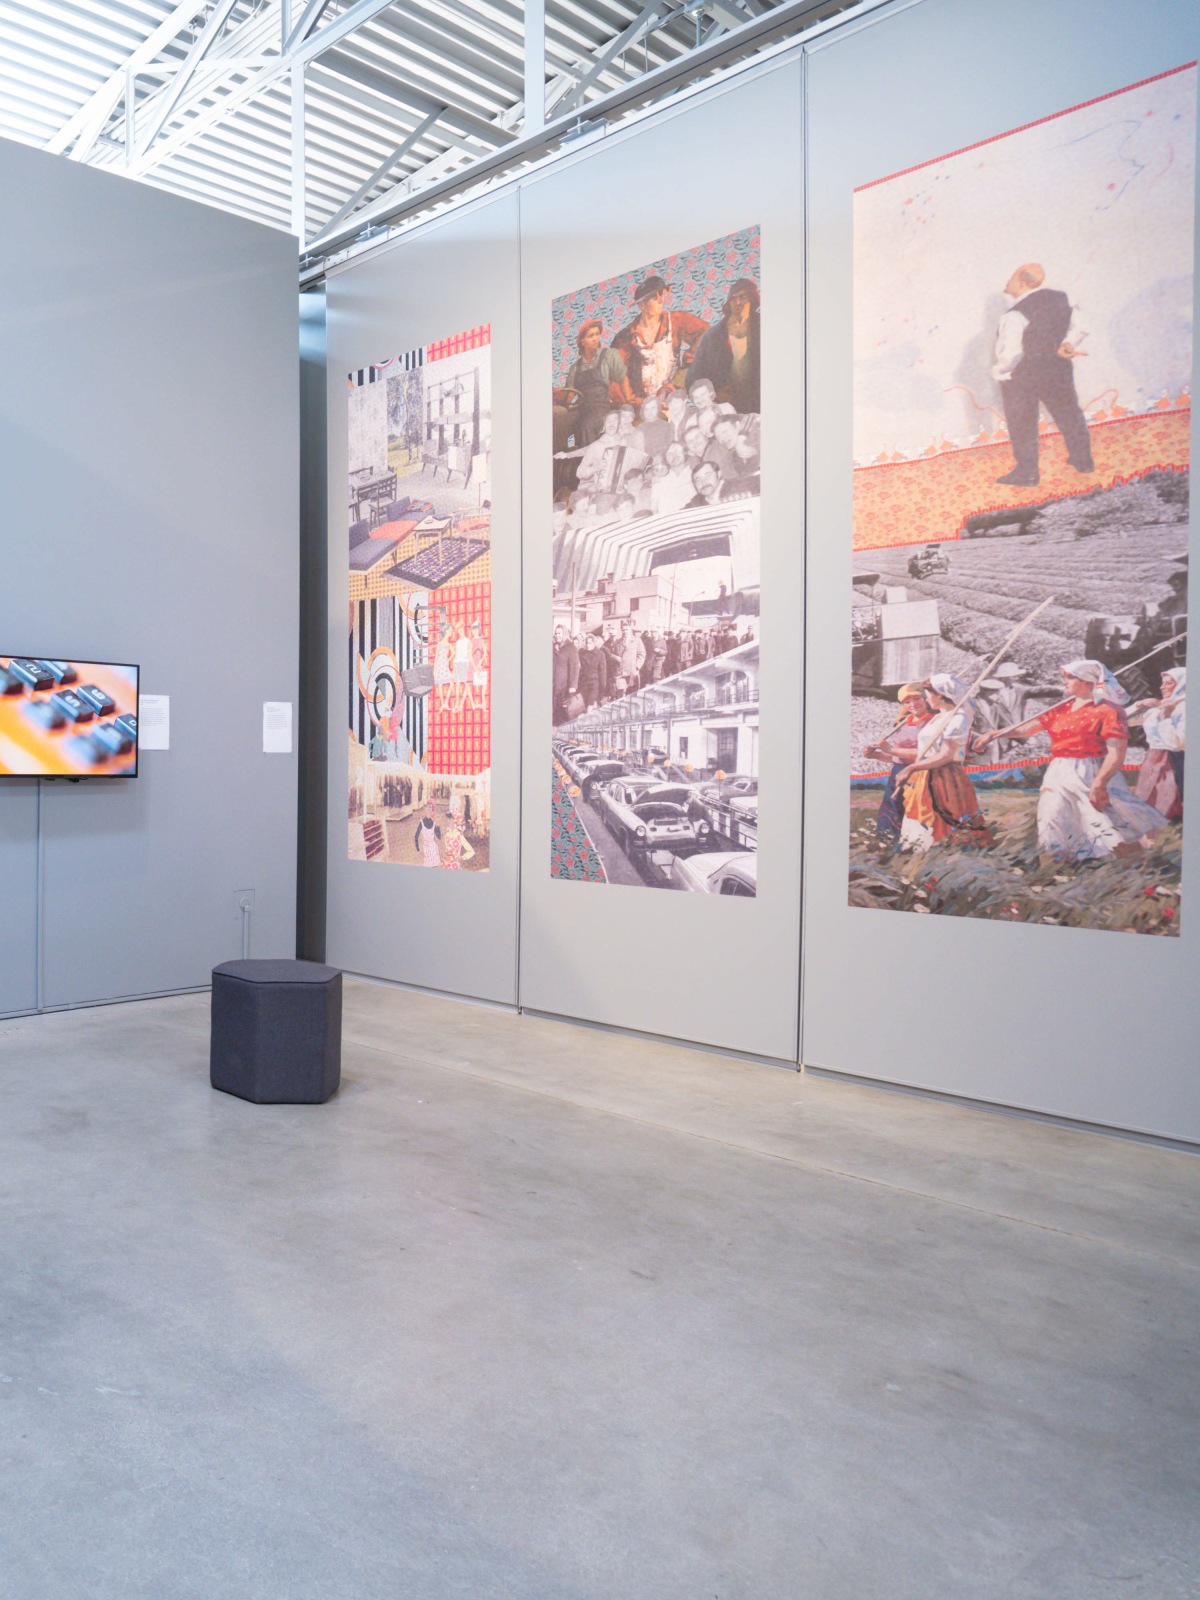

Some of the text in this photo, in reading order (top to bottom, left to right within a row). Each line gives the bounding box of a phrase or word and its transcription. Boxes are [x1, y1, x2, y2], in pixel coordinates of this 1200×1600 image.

[26, 664, 41, 674] 2
[91, 689, 106, 700] 6
[65, 695, 80, 707] 5
